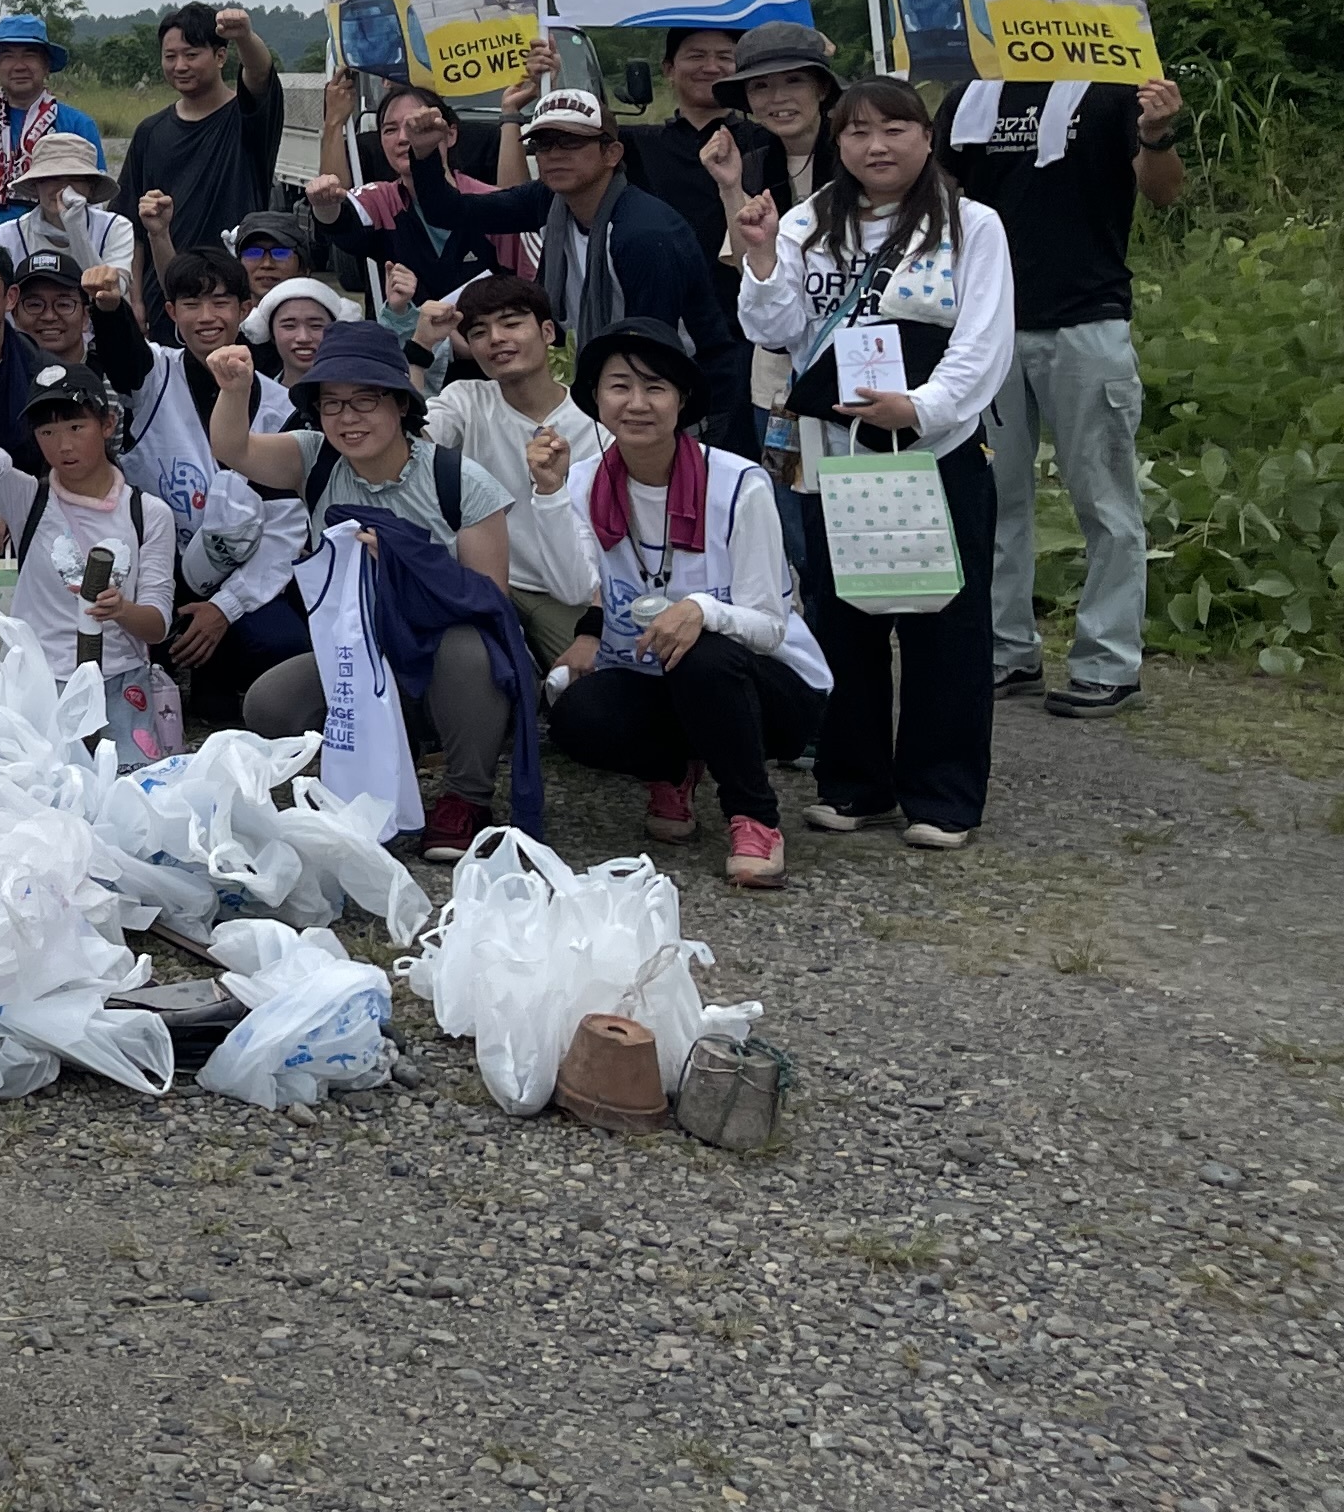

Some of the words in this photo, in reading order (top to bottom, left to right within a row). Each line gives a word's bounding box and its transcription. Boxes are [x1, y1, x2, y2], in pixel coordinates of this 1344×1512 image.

[1002, 20, 1115, 38] LIGHTLINE
[439, 32, 525, 61] LIGHTLINE
[1007, 41, 1054, 62] GO
[1061, 41, 1142, 69] WEST
[443, 59, 482, 84] GO
[487, 48, 531, 74] WES
[805, 272, 863, 297] ORT
